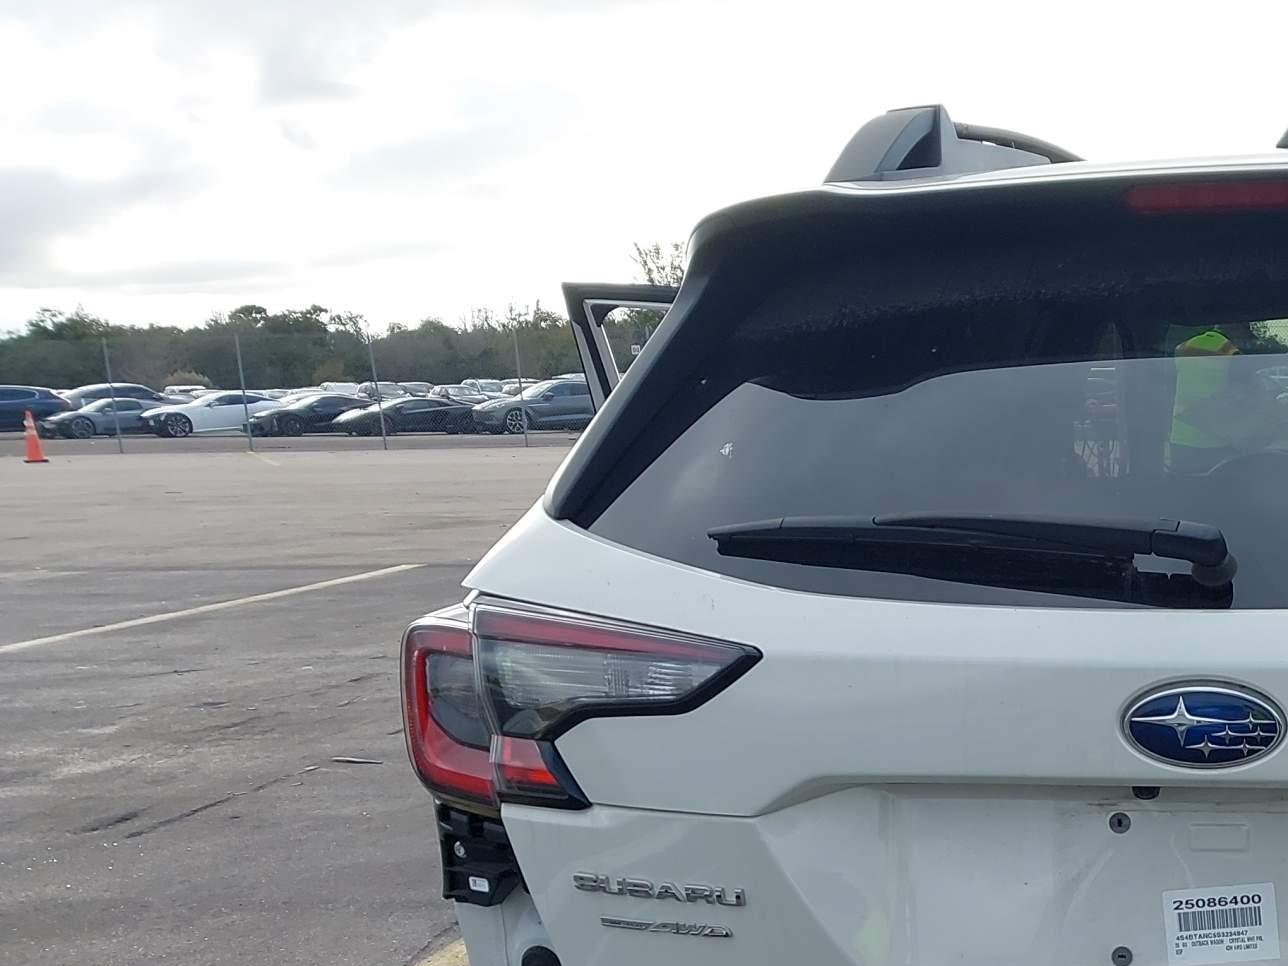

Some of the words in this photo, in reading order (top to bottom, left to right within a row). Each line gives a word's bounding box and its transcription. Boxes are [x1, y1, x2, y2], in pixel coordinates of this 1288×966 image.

[572, 871, 747, 906] SUBARU
[1172, 894, 1262, 911] 25086400
[648, 921, 734, 938] AWD
